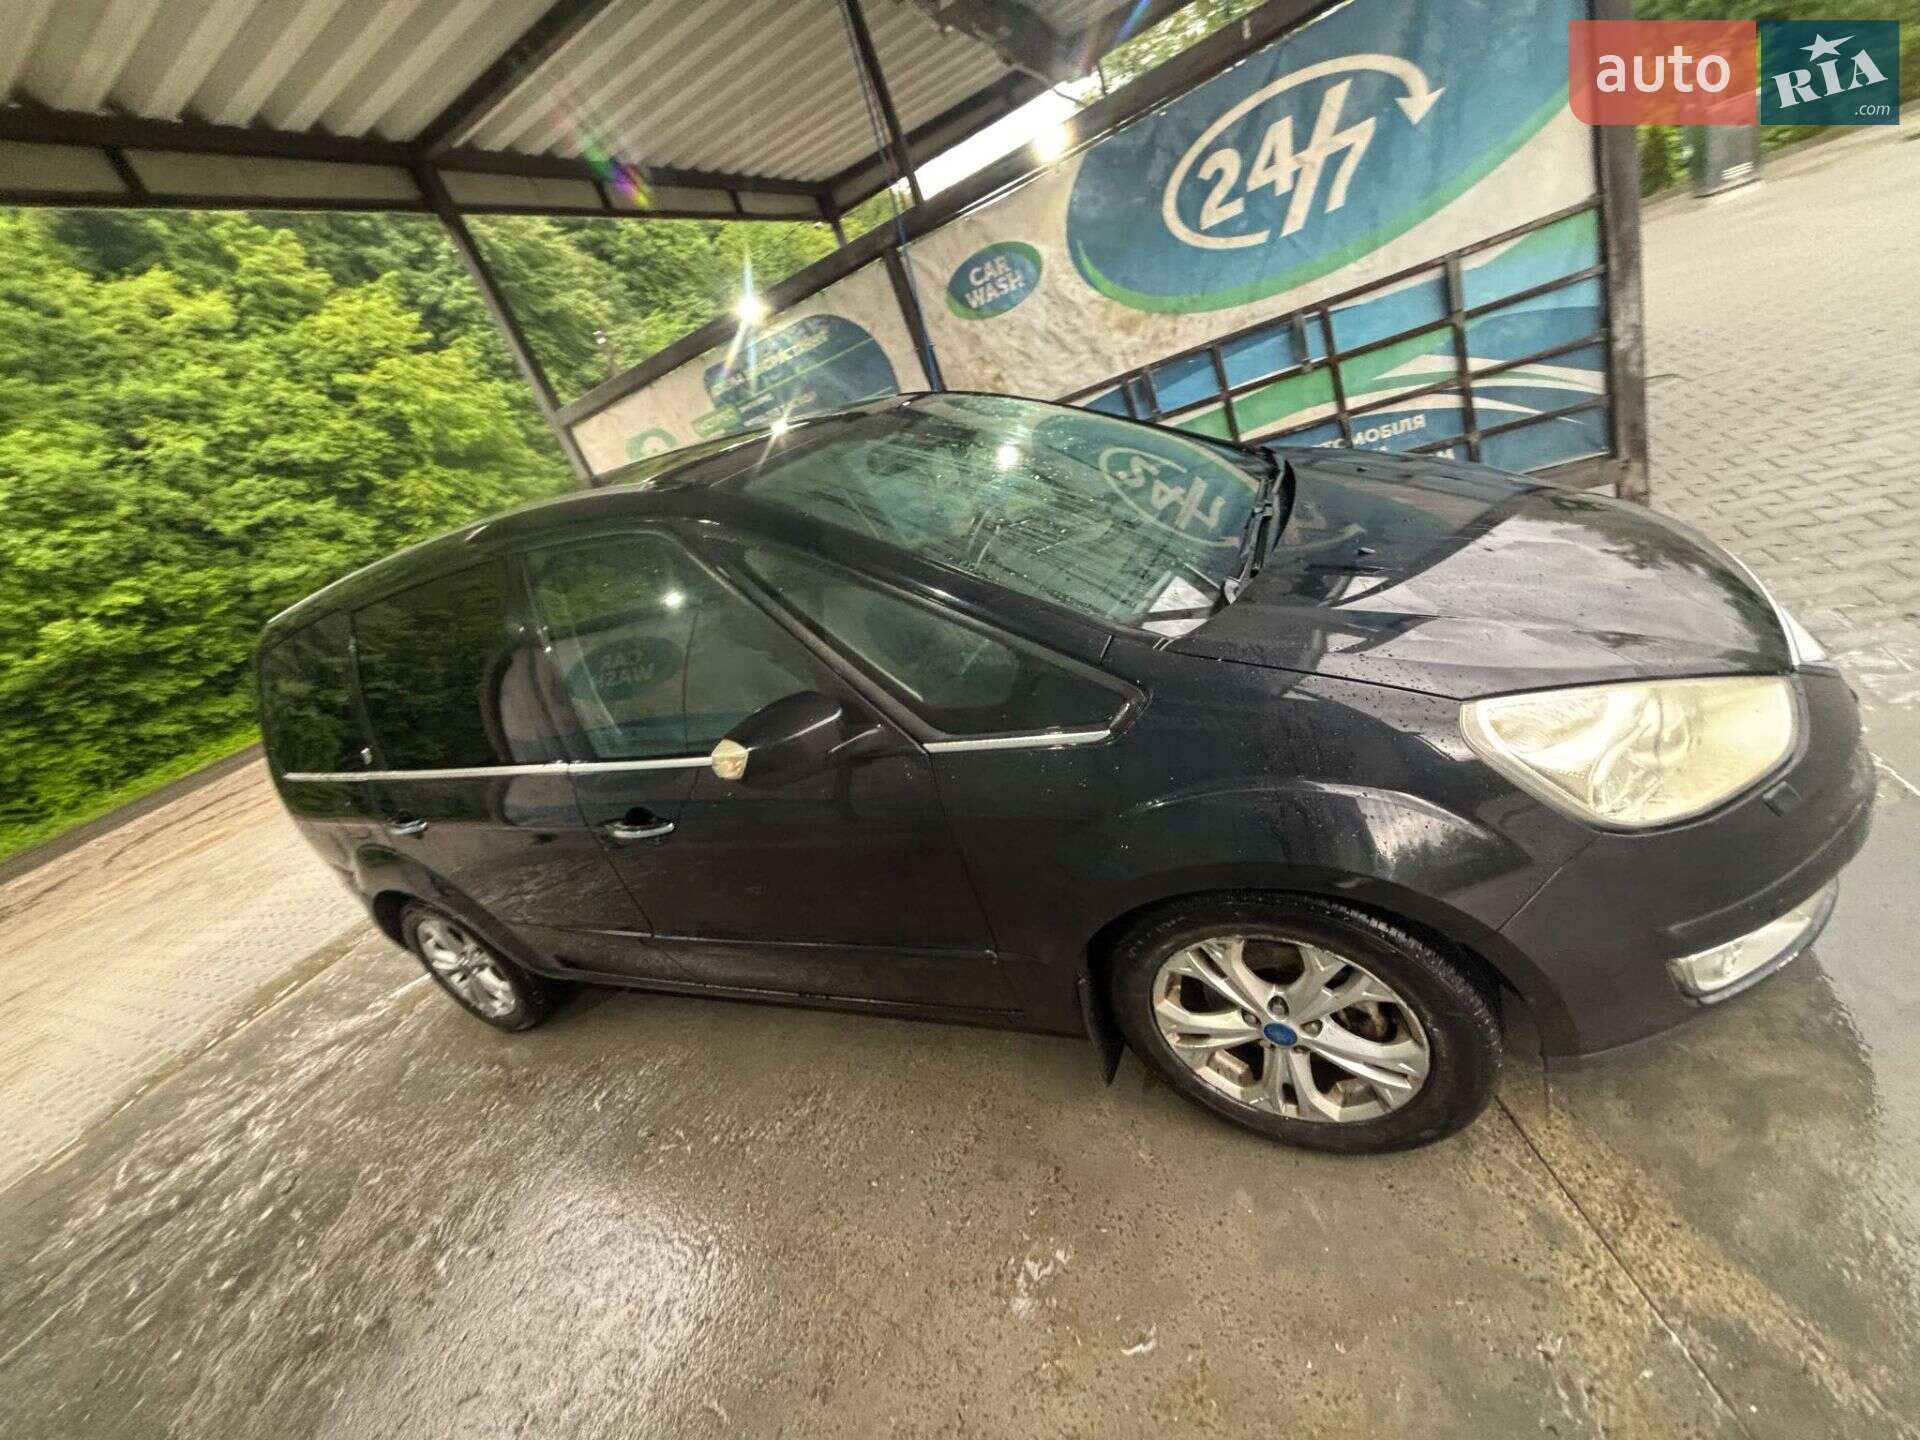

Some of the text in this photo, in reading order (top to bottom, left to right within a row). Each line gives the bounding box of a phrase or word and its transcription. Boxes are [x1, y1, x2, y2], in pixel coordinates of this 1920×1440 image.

[1198, 79, 1376, 238] 24/7
[965, 271, 1025, 309] WASH
[969, 256, 1011, 287] CAR
